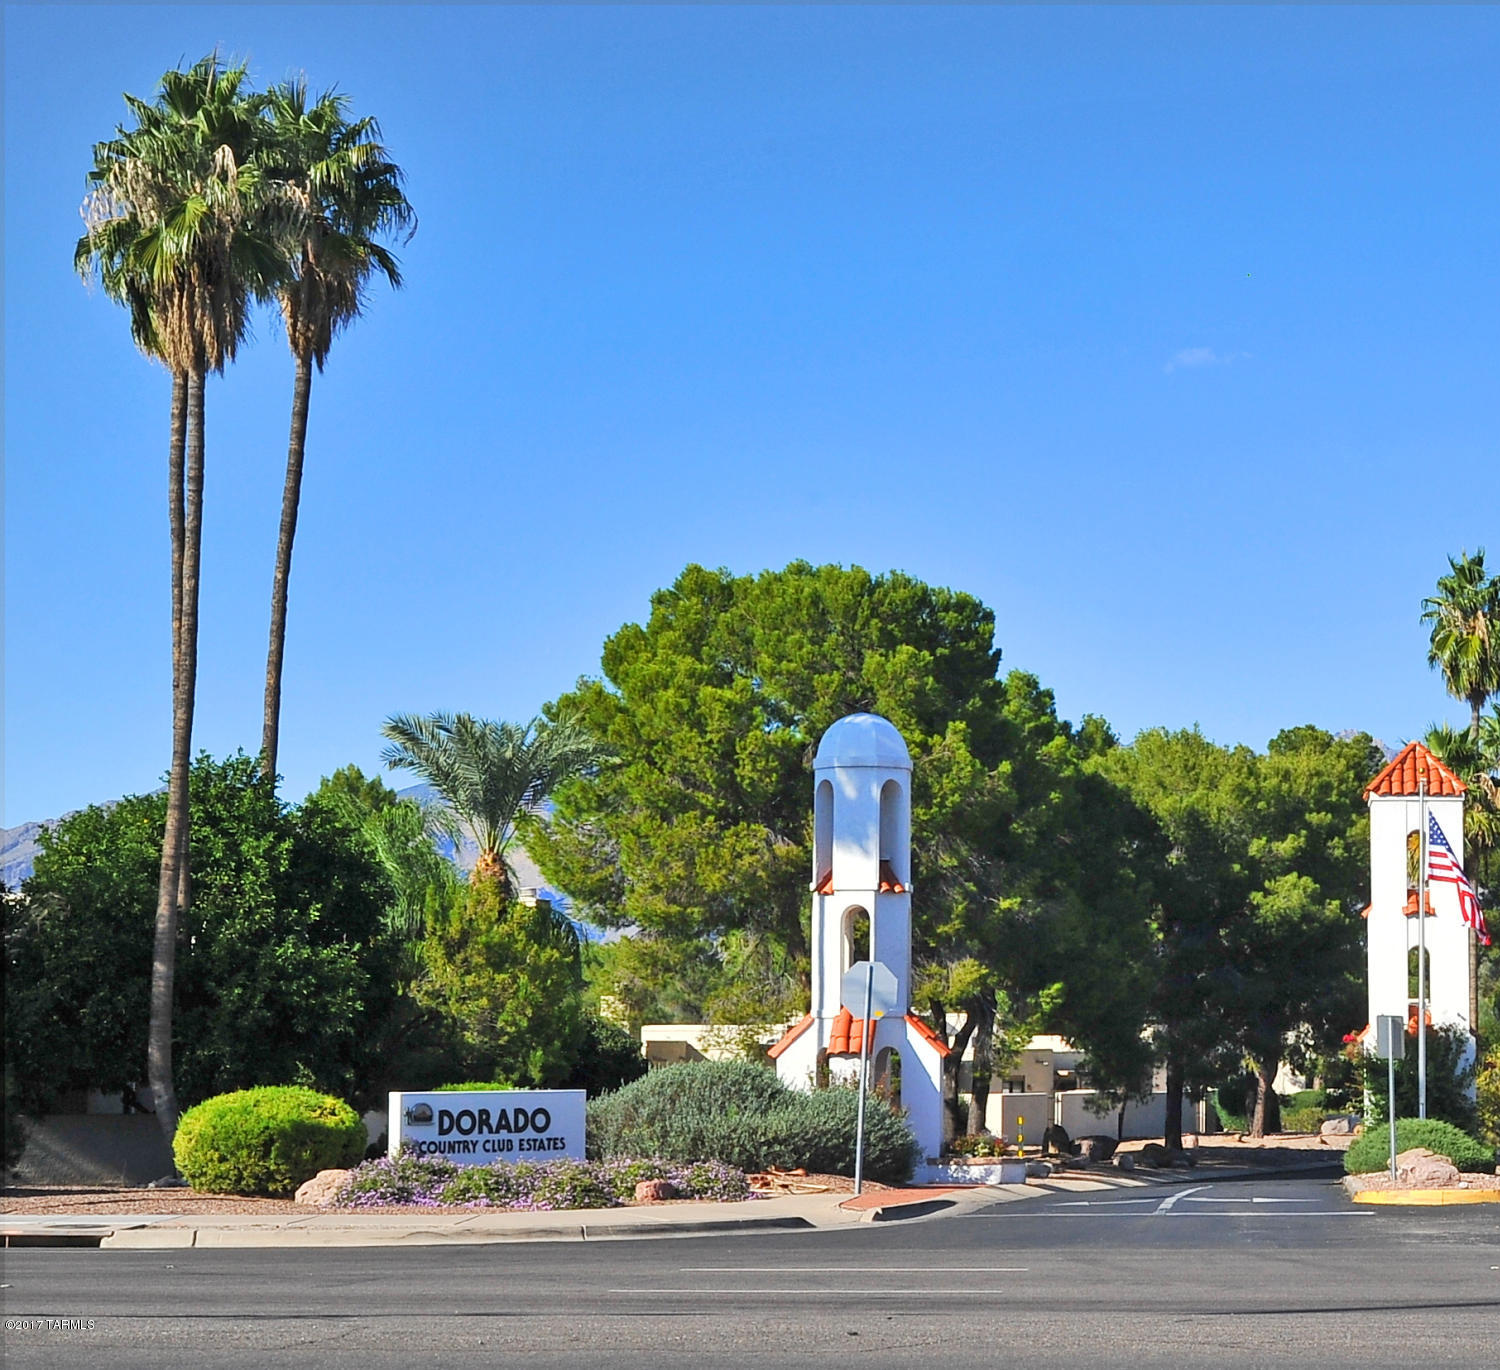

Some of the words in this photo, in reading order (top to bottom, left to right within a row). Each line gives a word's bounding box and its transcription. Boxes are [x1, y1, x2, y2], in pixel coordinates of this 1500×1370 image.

[438, 1107, 551, 1136] DORADO
[419, 1140, 479, 1155] COUNTRY
[484, 1138, 514, 1153] CLUB
[519, 1137, 566, 1151] ESTATES
